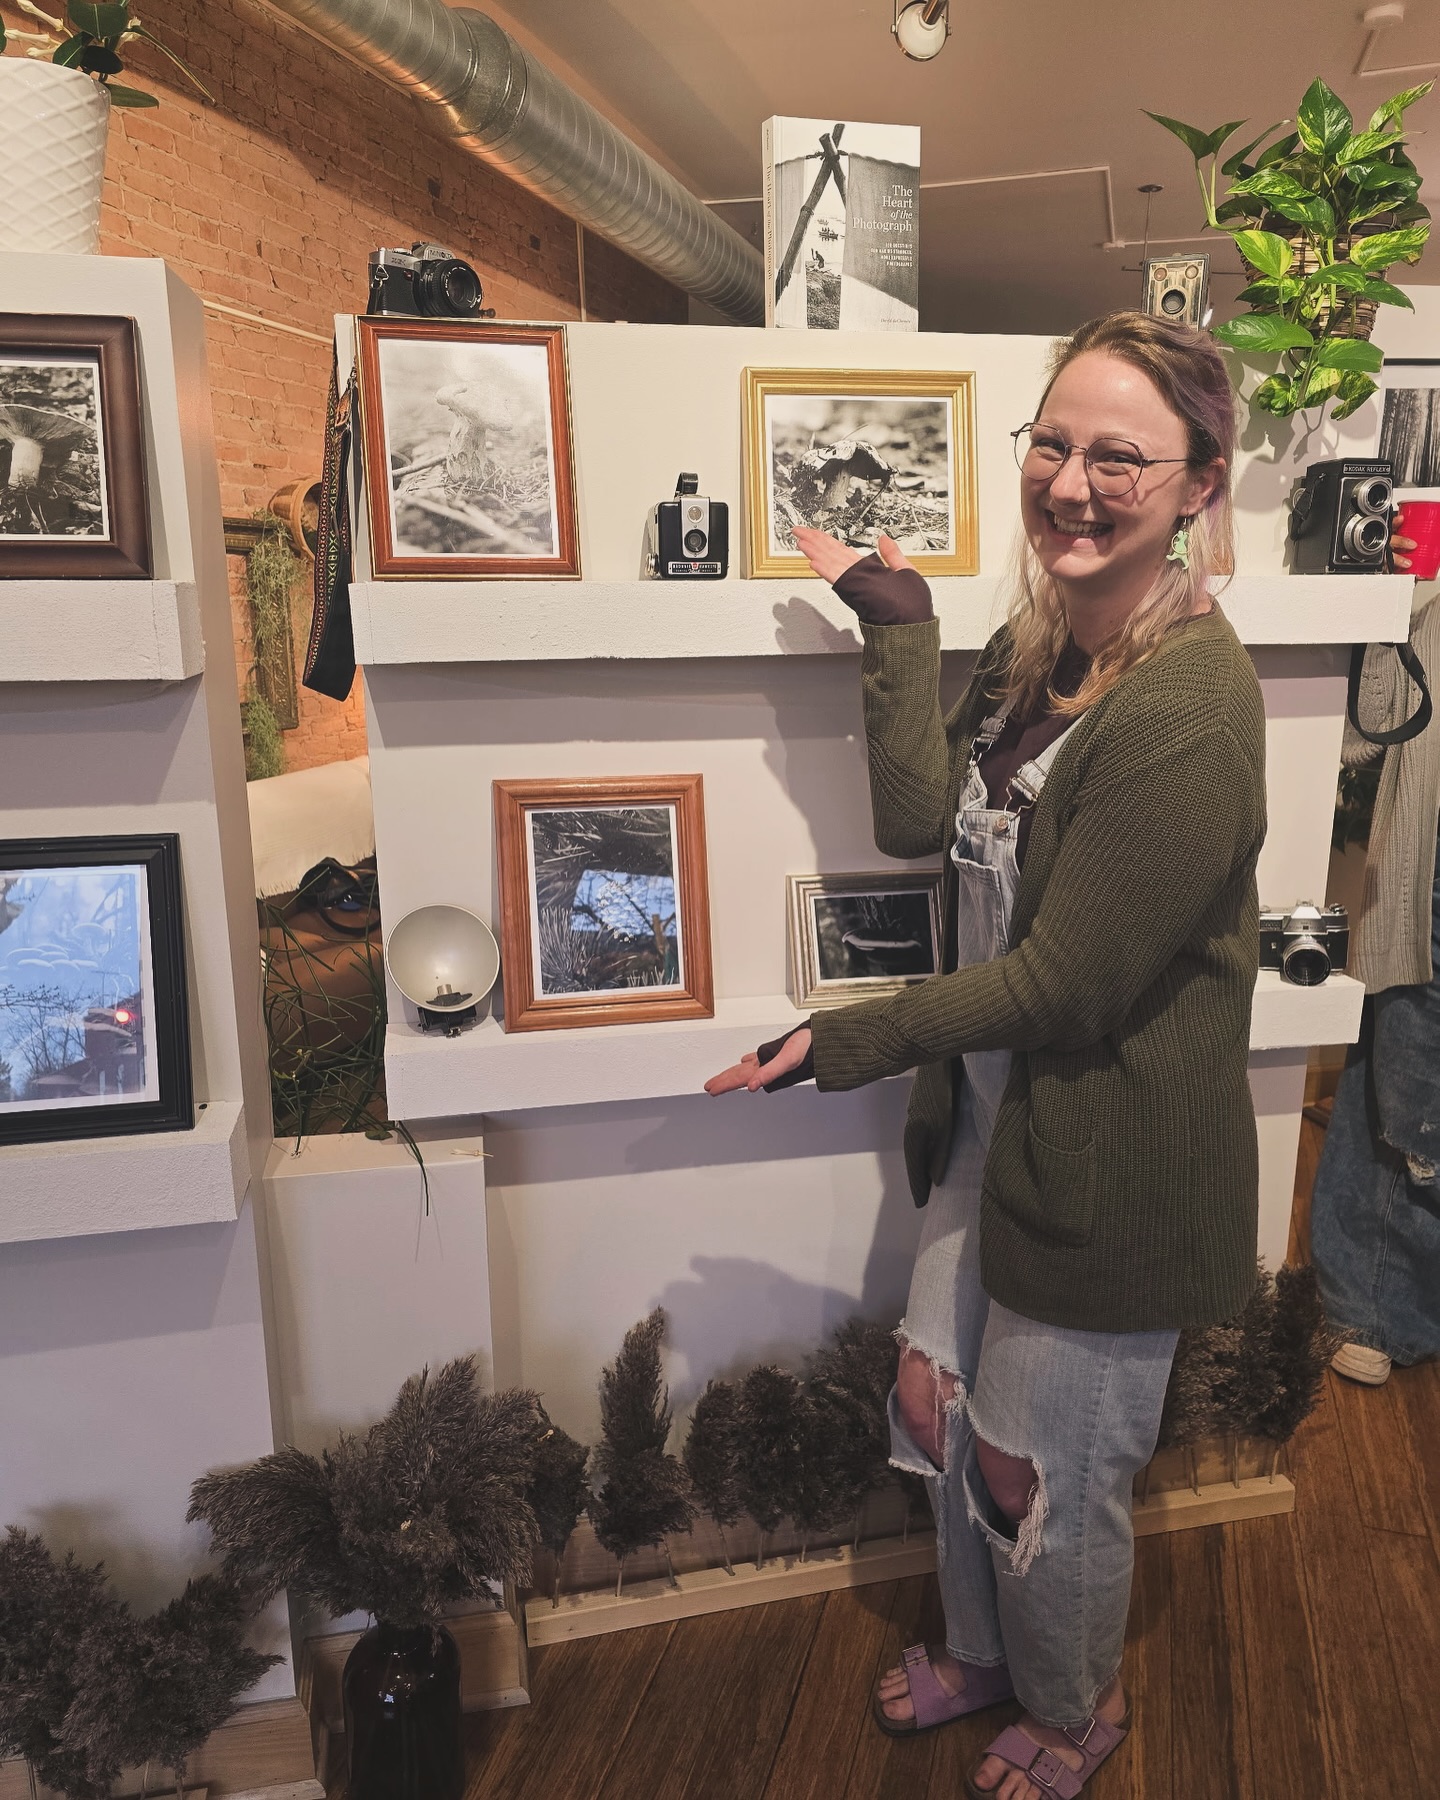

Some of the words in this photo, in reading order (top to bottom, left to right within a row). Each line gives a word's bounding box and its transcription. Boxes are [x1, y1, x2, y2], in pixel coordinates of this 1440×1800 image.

[892, 184, 913, 197] The
[882, 195, 913, 208] Heart
[890, 209, 901, 221] of
[900, 209, 913, 219] the
[852, 217, 912, 233] Photograph
